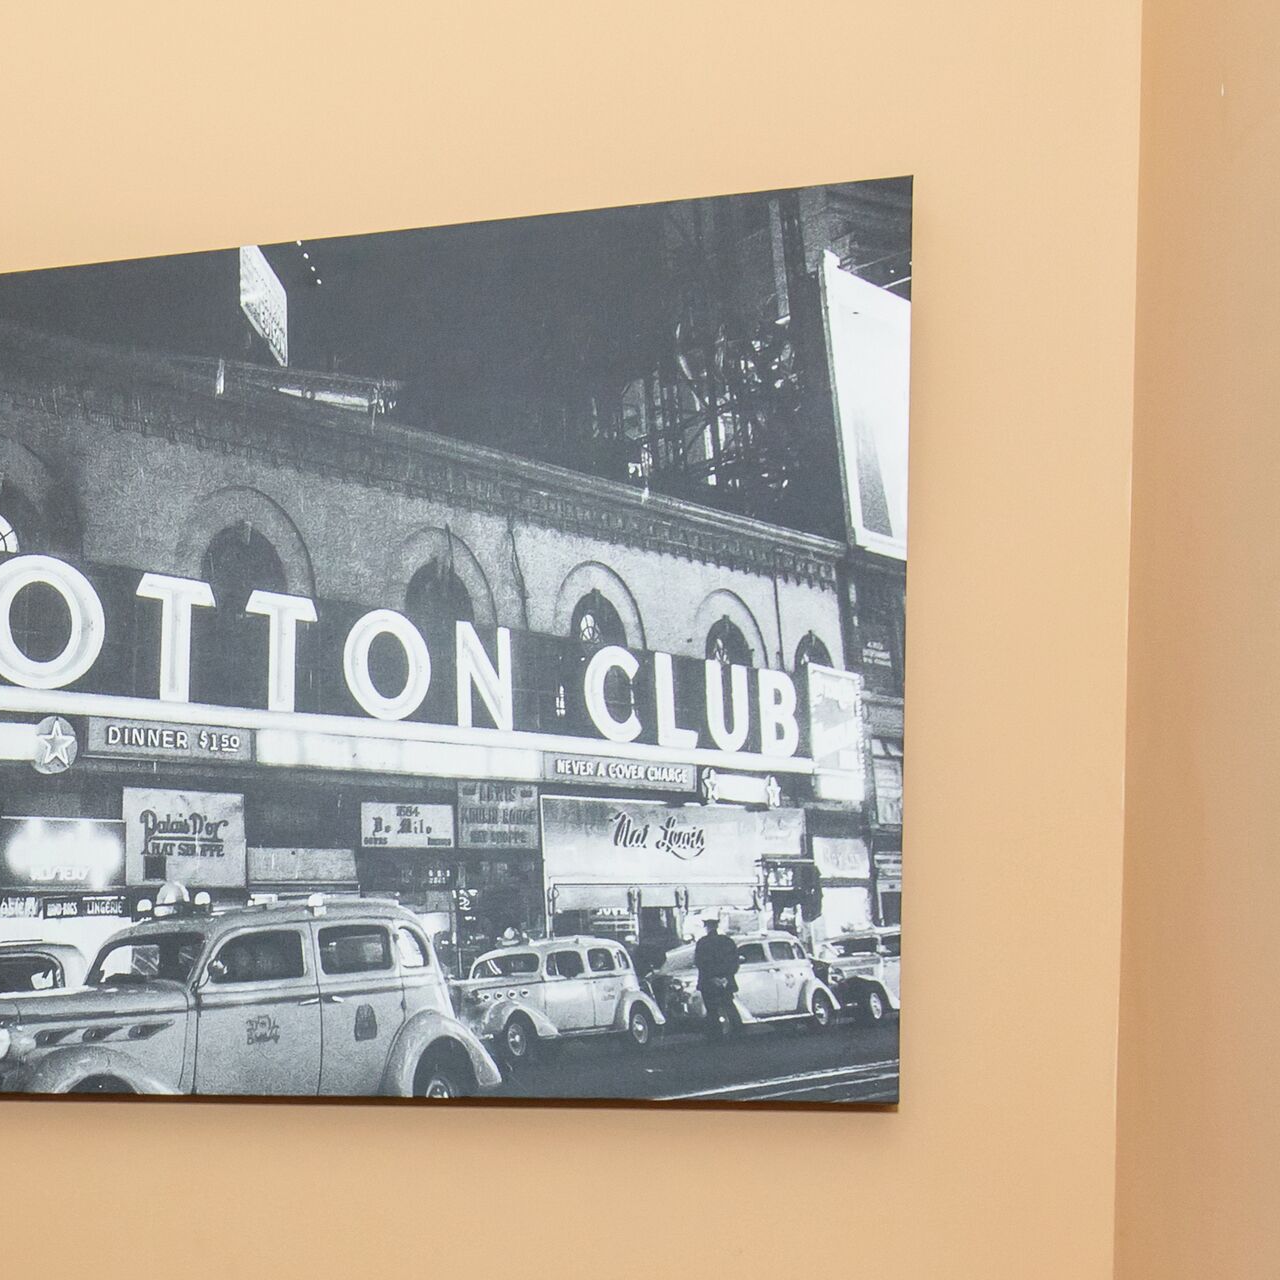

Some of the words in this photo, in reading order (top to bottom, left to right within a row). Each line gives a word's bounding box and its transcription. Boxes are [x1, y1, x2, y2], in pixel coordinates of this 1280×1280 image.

[583, 644, 801, 759] CLUB
[107, 726, 188, 749] DINNER
[556, 759, 594, 776] NEVER
[596, 762, 606, 777] A
[608, 763, 645, 780] COVER
[646, 767, 689, 783] CHARGE
[608, 811, 650, 849] Nat
